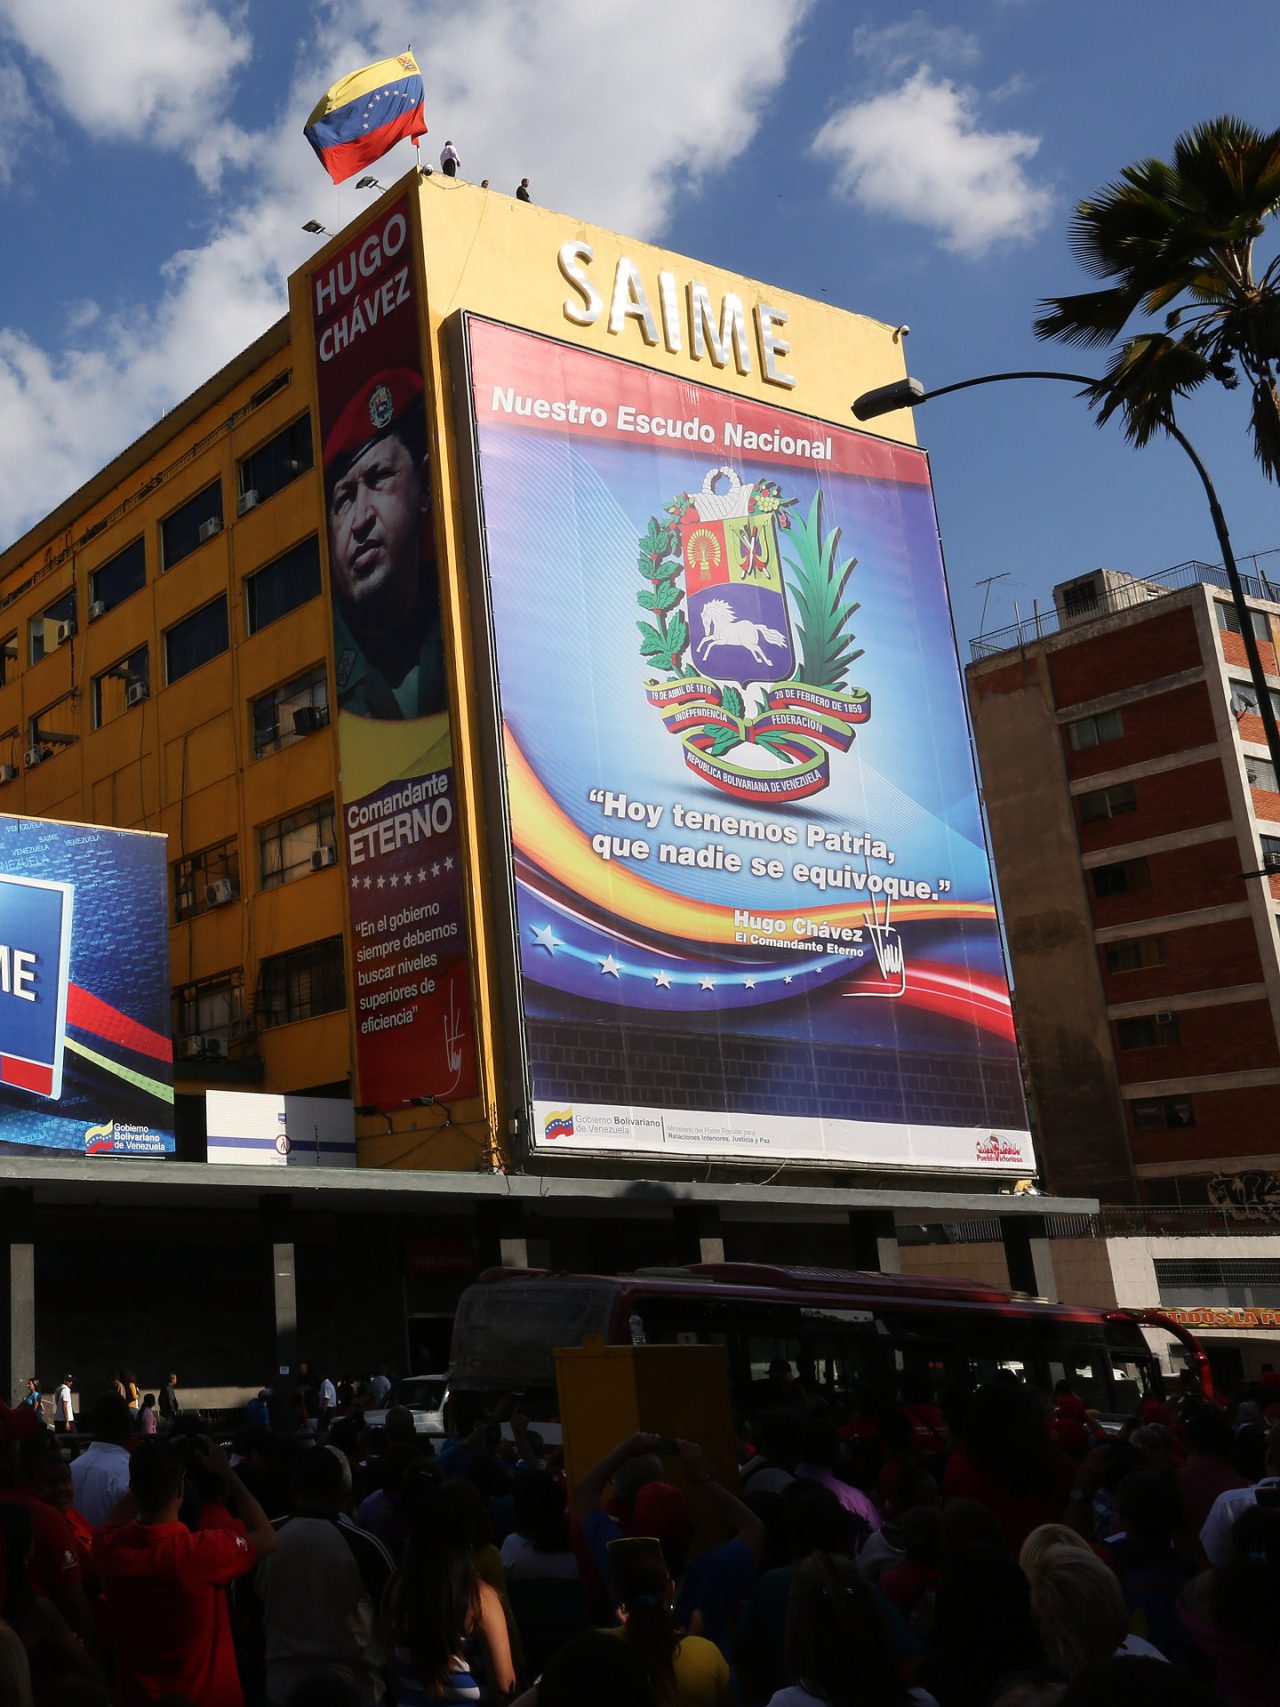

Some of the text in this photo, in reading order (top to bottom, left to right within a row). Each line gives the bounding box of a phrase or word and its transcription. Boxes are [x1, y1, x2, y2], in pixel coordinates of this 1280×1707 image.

[316, 213, 407, 316] HUGO
[320, 266, 411, 362] CHÁVEZ
[557, 240, 797, 389] SAIME
[491, 385, 832, 460] Nuestro Escudo Nacional
[652, 684, 712, 700] 19 DE ABRIL DE 1810
[775, 689, 862, 714] 20 DE FEBRERO DE 1859
[675, 707, 728, 722] INDEPENDENCIA
[771, 714, 823, 733] FEDERACION
[687, 752, 822, 792] REPUBLICA BOLIVARIANA DE VENEZUELA
[347, 774, 448, 829] Comandante
[5, 822, 44, 833] VENEZUELA
[38, 833, 59, 843] SAIME
[349, 797, 452, 865] ETERNO
[672, 803, 798, 845] tenemos
[807, 823, 895, 864] Patria,
[11, 844, 50, 857] VENEZUELA
[64, 834, 101, 847] VENEZUELA
[592, 833, 650, 860] que
[659, 843, 742, 872] nadie
[751, 856, 784, 879] se
[377, 915, 387, 932] el
[389, 902, 440, 932] gobierno
[734, 909, 864, 943] Hugo Chávez
[357, 921, 458, 963] siempre debemos
[735, 931, 865, 957] El Comandante Eterno
[358, 952, 438, 986] buscar niveles
[359, 978, 436, 1010] superiores de
[114, 1122, 149, 1132] Gobierno
[575, 1114, 661, 1128] Gobierno Bolivariano
[576, 1125, 630, 1134] de Venezuela
[114, 1132, 160, 1142] Bolivariano
[126, 1142, 165, 1151] Venezuela
[668, 1132, 700, 1140] Relaciones
[1160, 1311, 1229, 1324] TIDOS
[1233, 1312, 1259, 1325] LA
